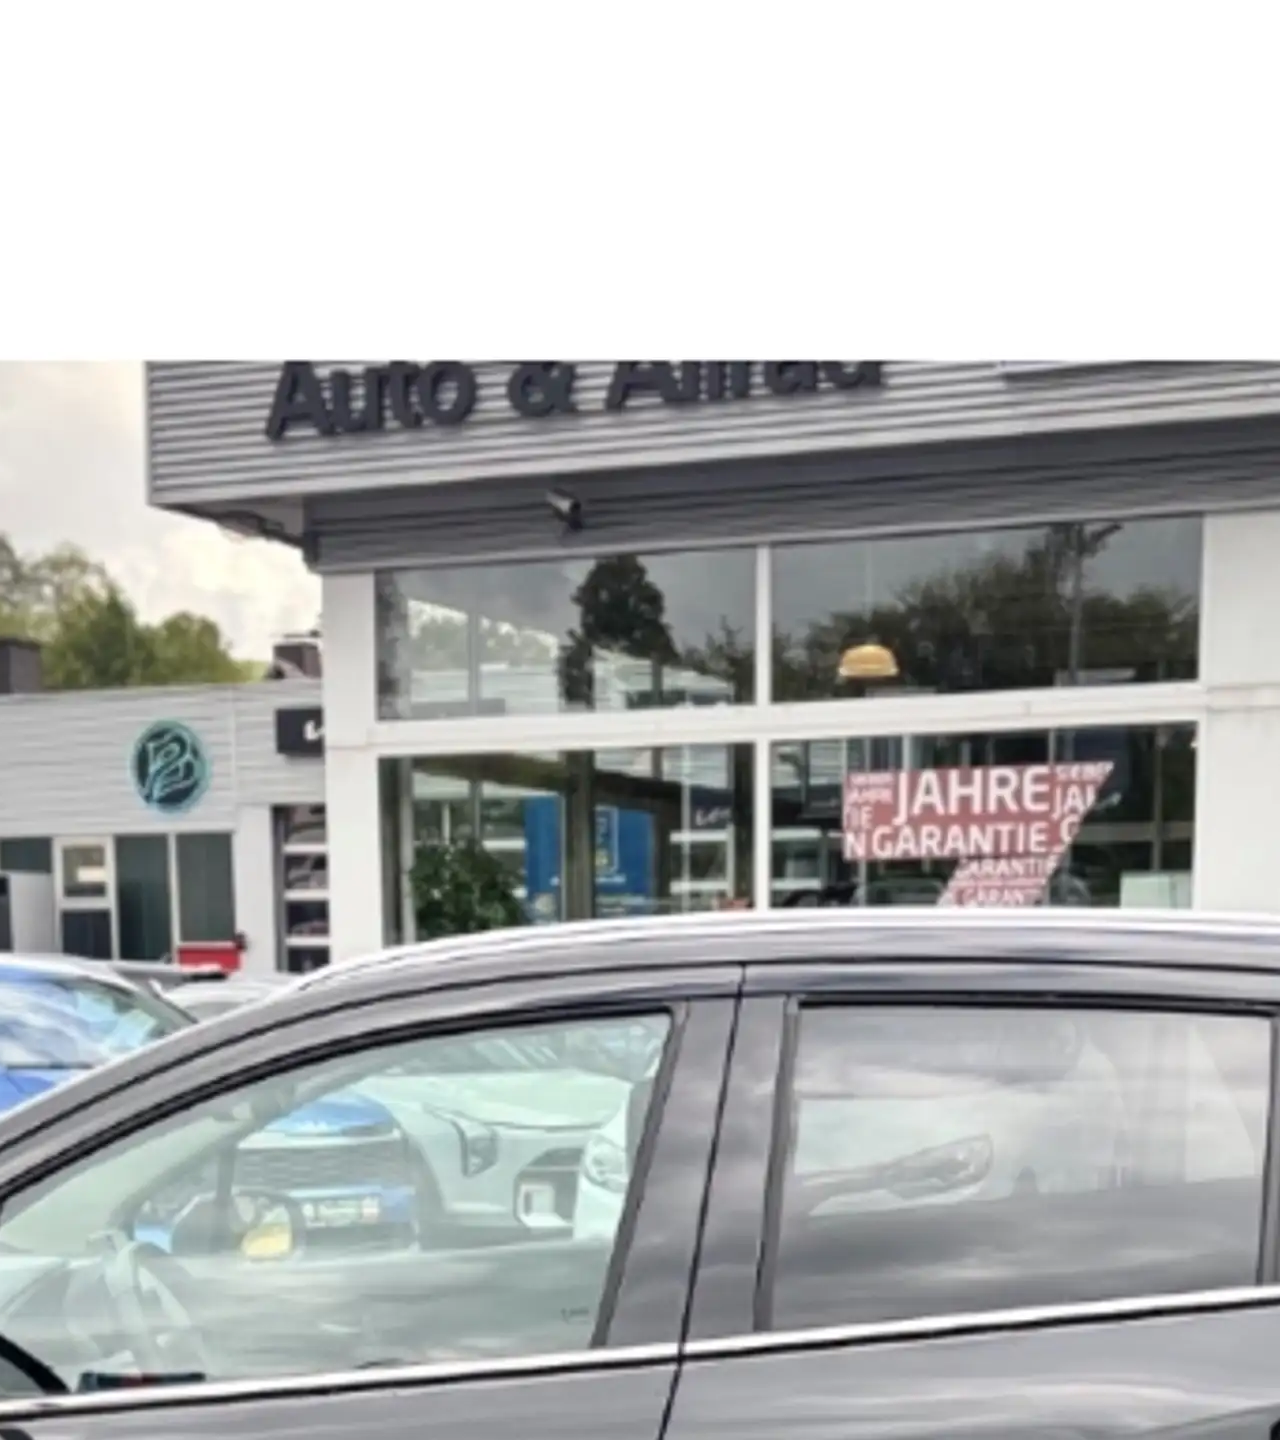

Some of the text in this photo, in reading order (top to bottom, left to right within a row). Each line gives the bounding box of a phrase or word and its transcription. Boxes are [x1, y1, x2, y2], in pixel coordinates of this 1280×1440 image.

[265, 361, 478, 440] Auto
[892, 765, 1051, 825] JAHRE
[871, 820, 1049, 858] GARANTIE
